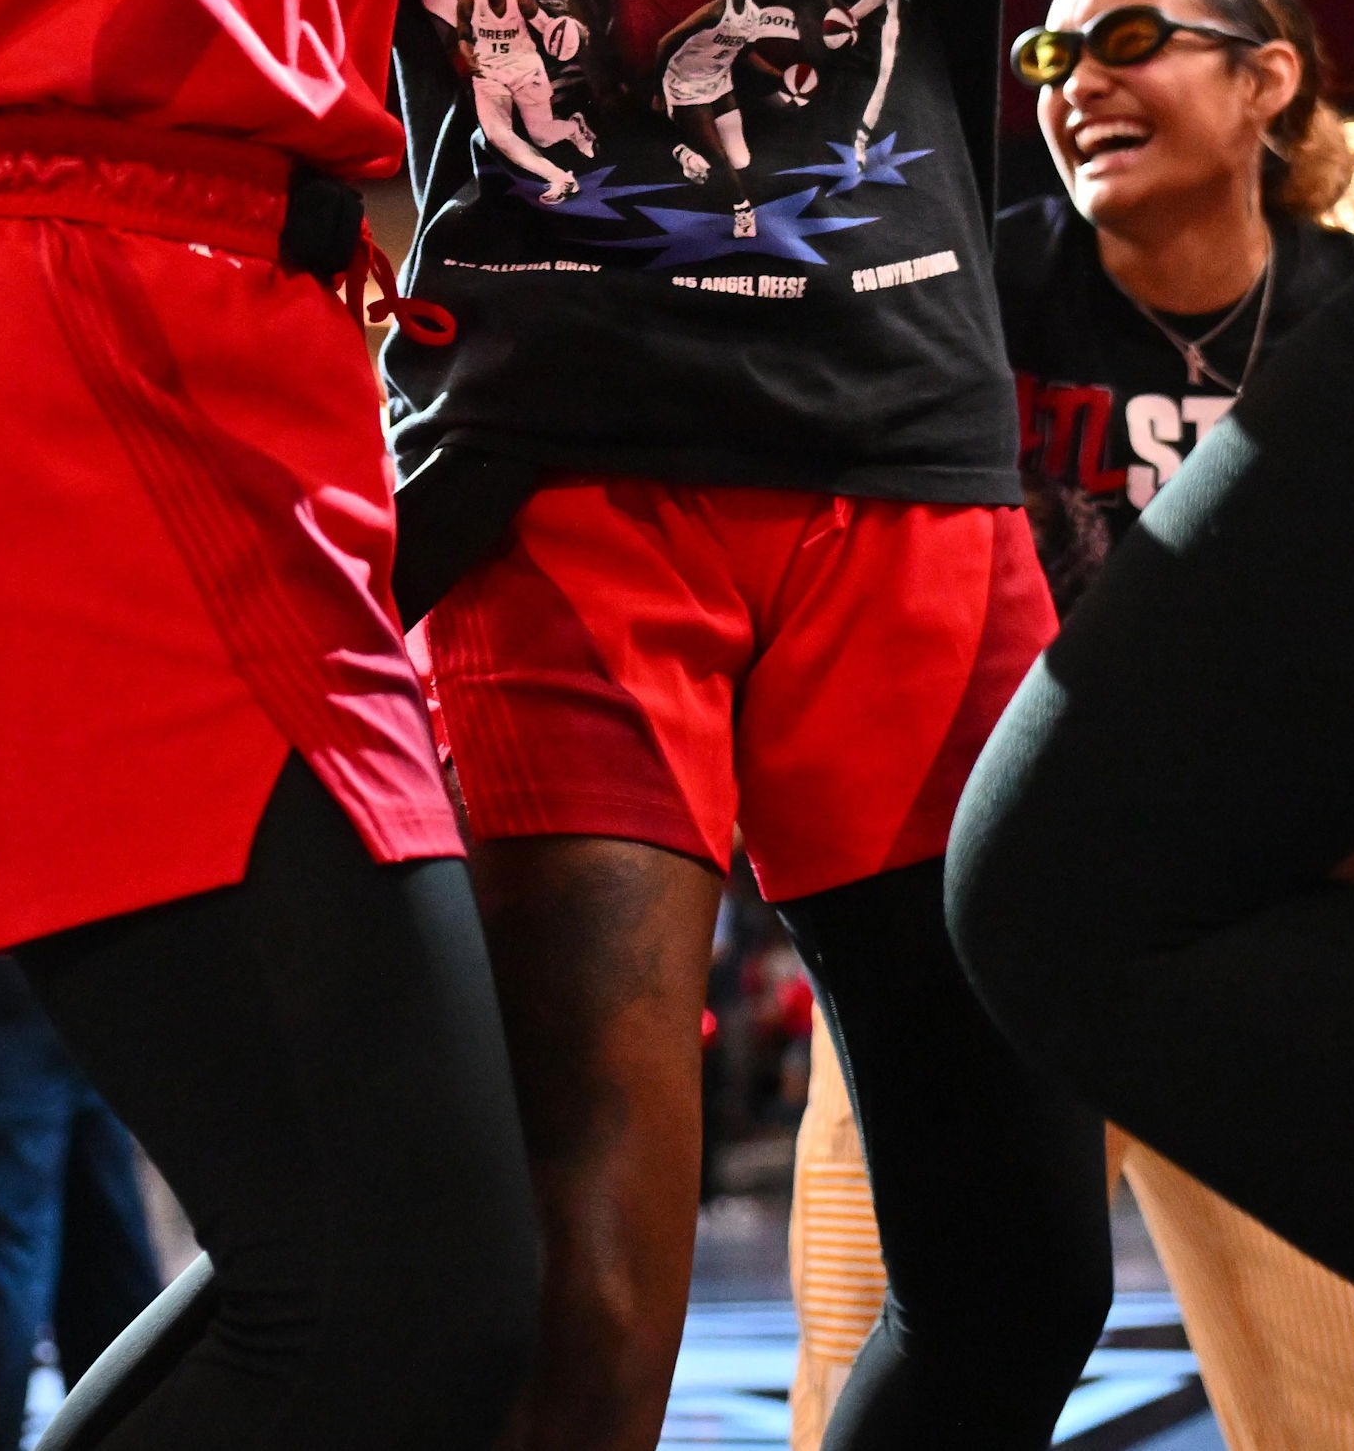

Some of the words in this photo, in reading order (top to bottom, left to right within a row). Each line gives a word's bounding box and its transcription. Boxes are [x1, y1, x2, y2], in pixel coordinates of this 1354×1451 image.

[492, 42, 510, 54] 15
[672, 276, 698, 288] #5
[700, 275, 755, 296] ANGEL
[757, 274, 808, 298] REESE
